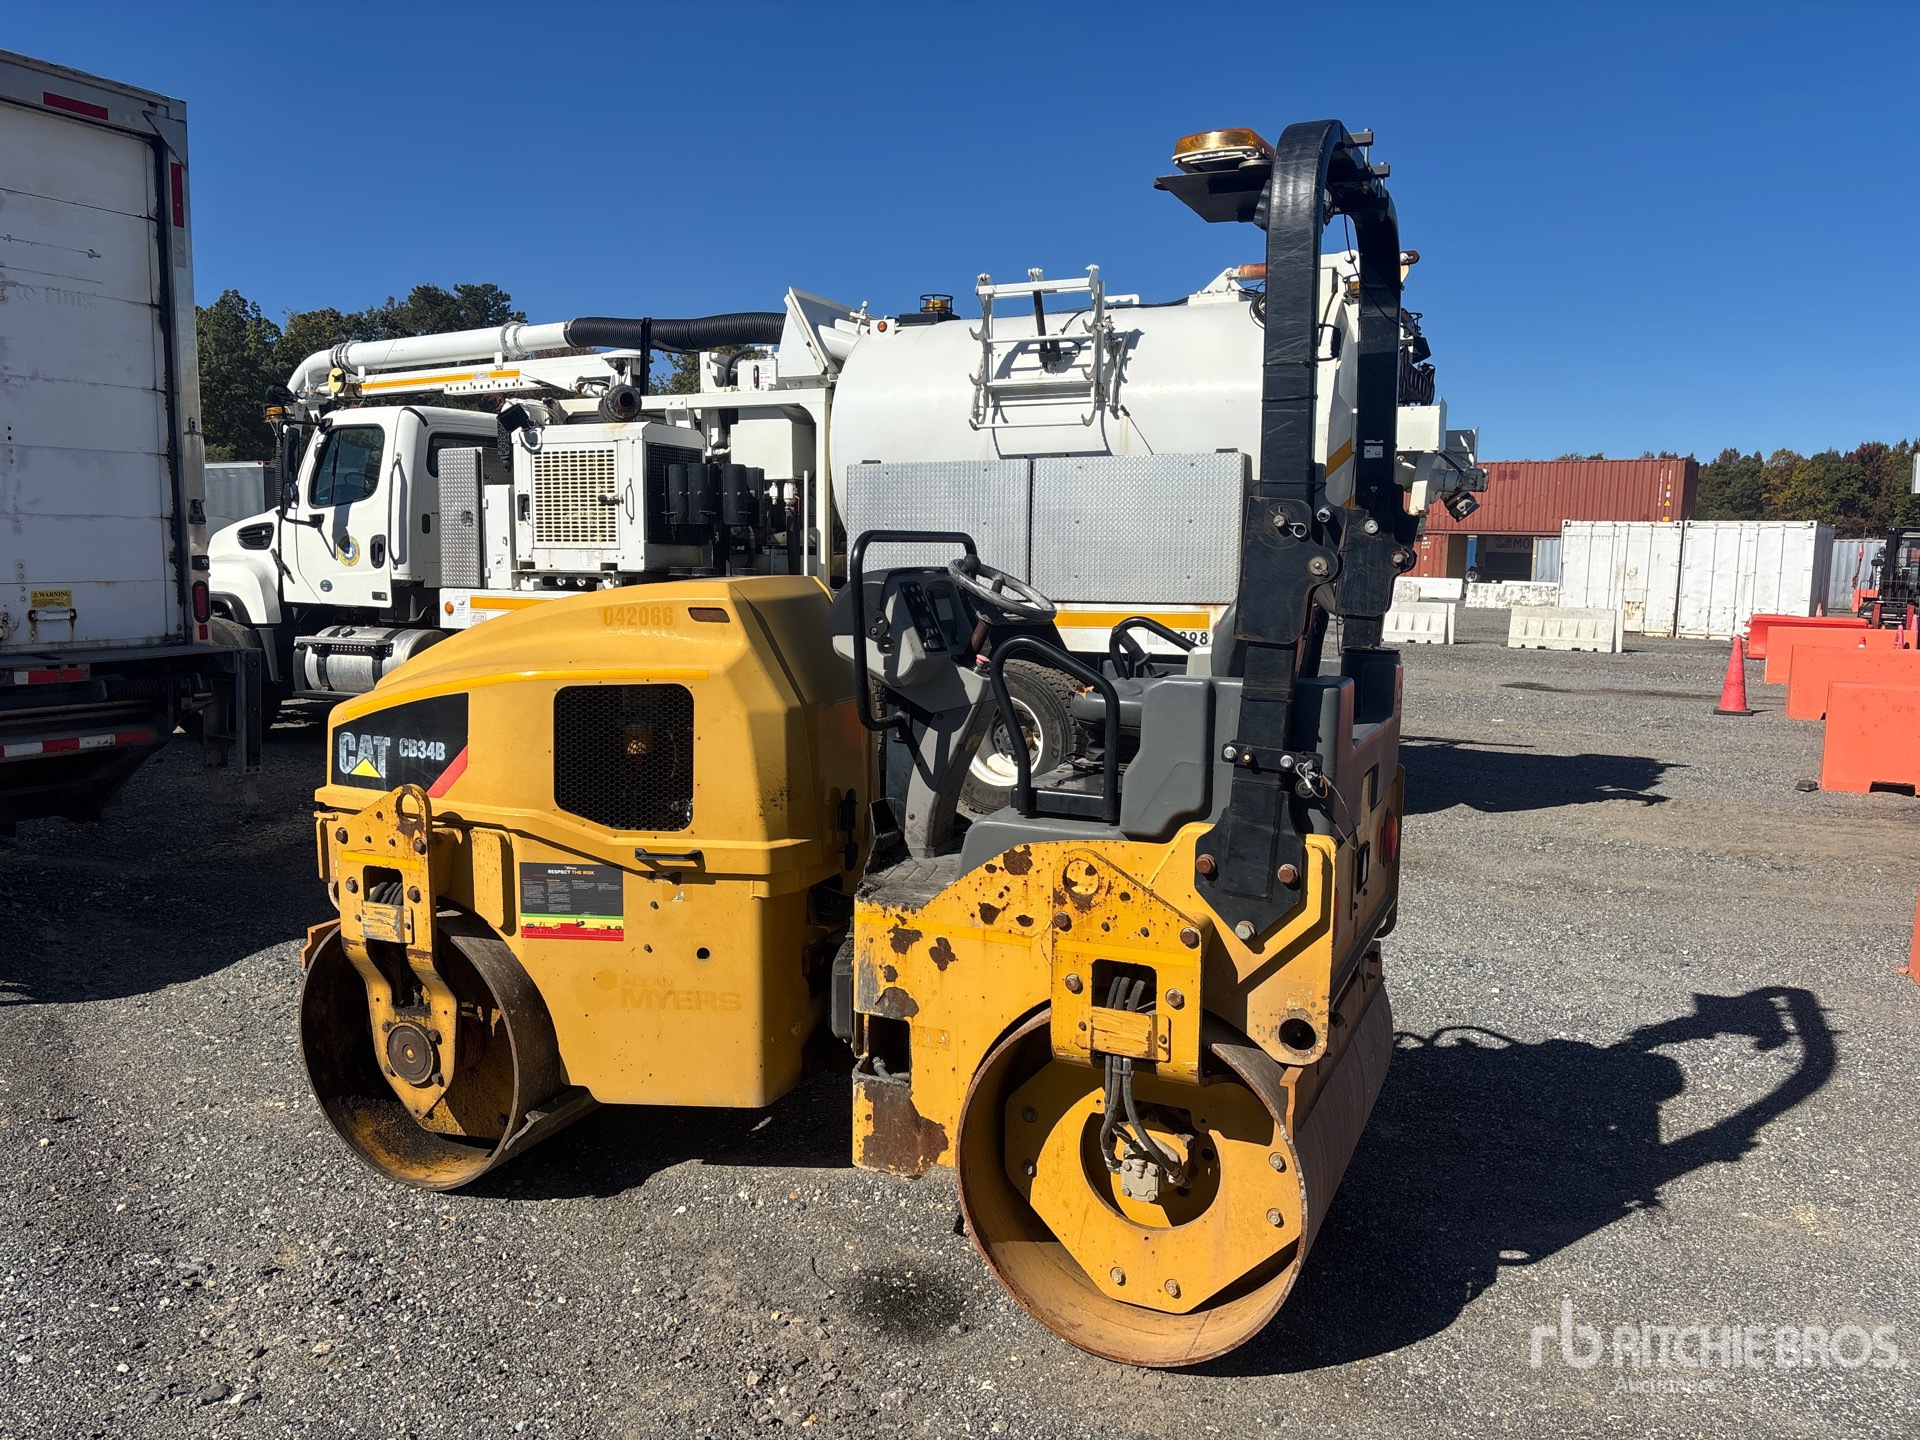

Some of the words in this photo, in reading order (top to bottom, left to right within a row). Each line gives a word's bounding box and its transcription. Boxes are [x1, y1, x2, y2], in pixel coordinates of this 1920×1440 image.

[603, 606, 674, 627] 042066
[339, 731, 391, 779] CAT
[399, 737, 446, 761] CB34B
[620, 988, 743, 1012] MYERS
